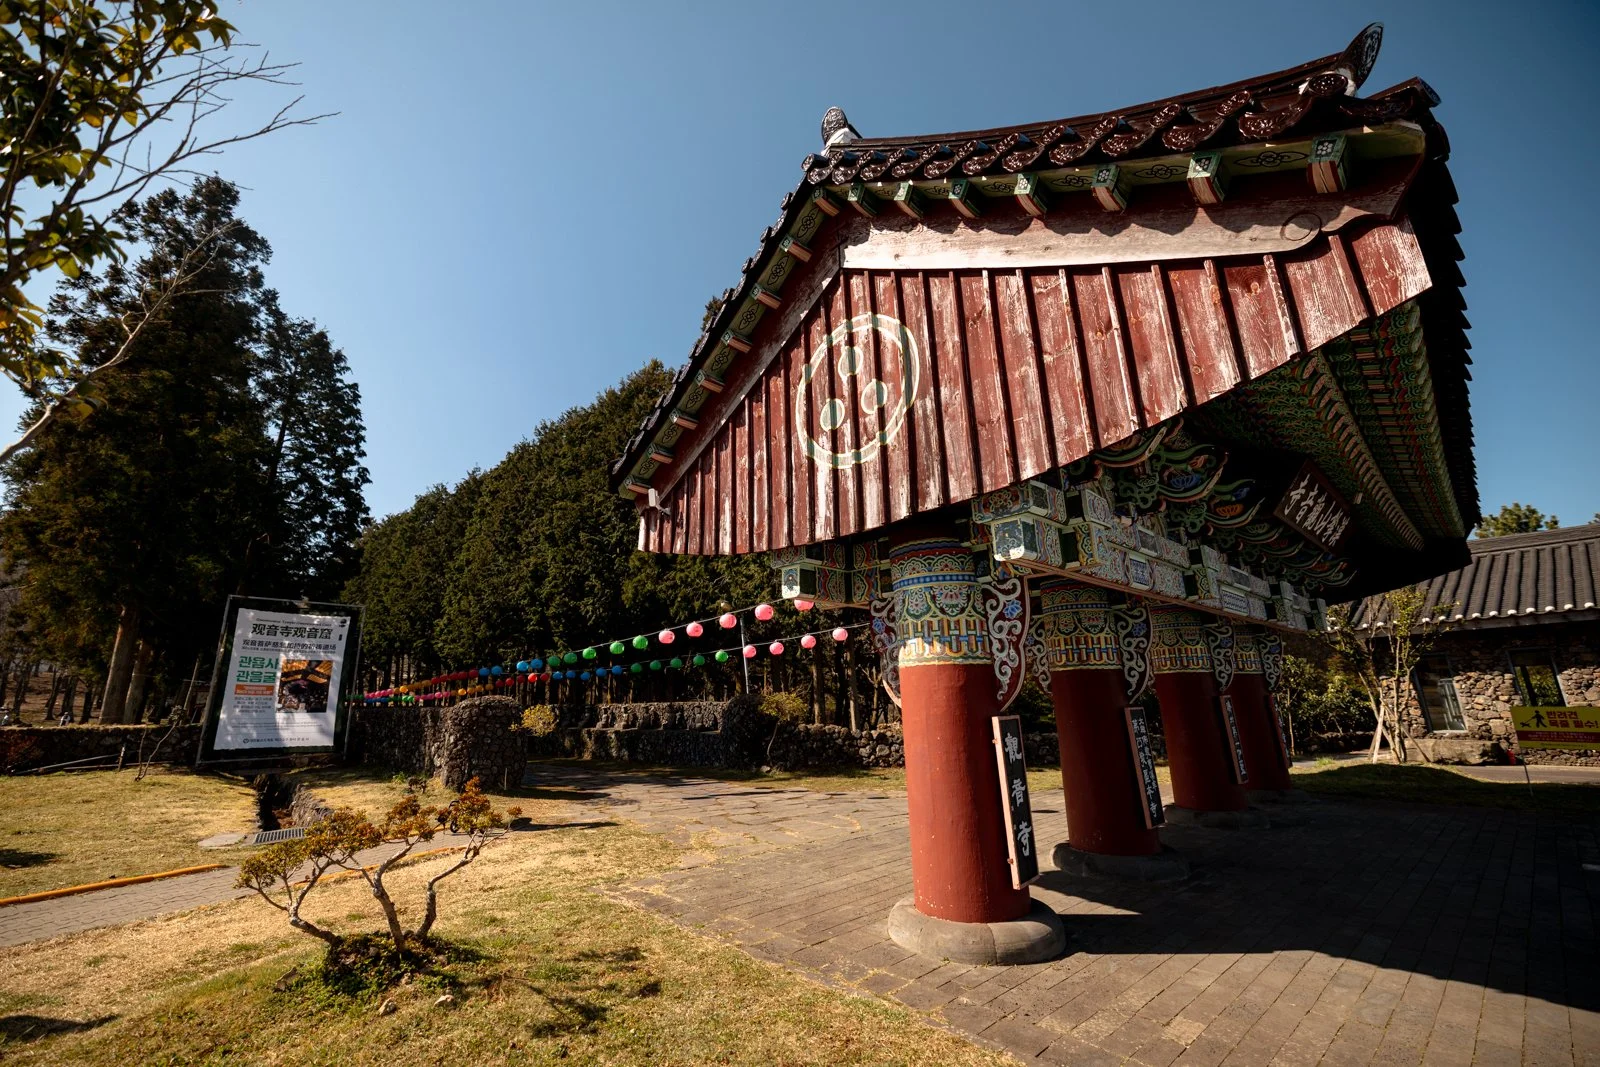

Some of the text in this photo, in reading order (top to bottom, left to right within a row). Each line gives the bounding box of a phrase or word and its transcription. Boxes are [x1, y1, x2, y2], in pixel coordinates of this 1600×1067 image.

[251, 623, 333, 639] 观音寺观音窟
[239, 656, 279, 669] 관음사
[236, 670, 277, 683] 관음굴
[1005, 732, 1032, 857] 觀音寺
